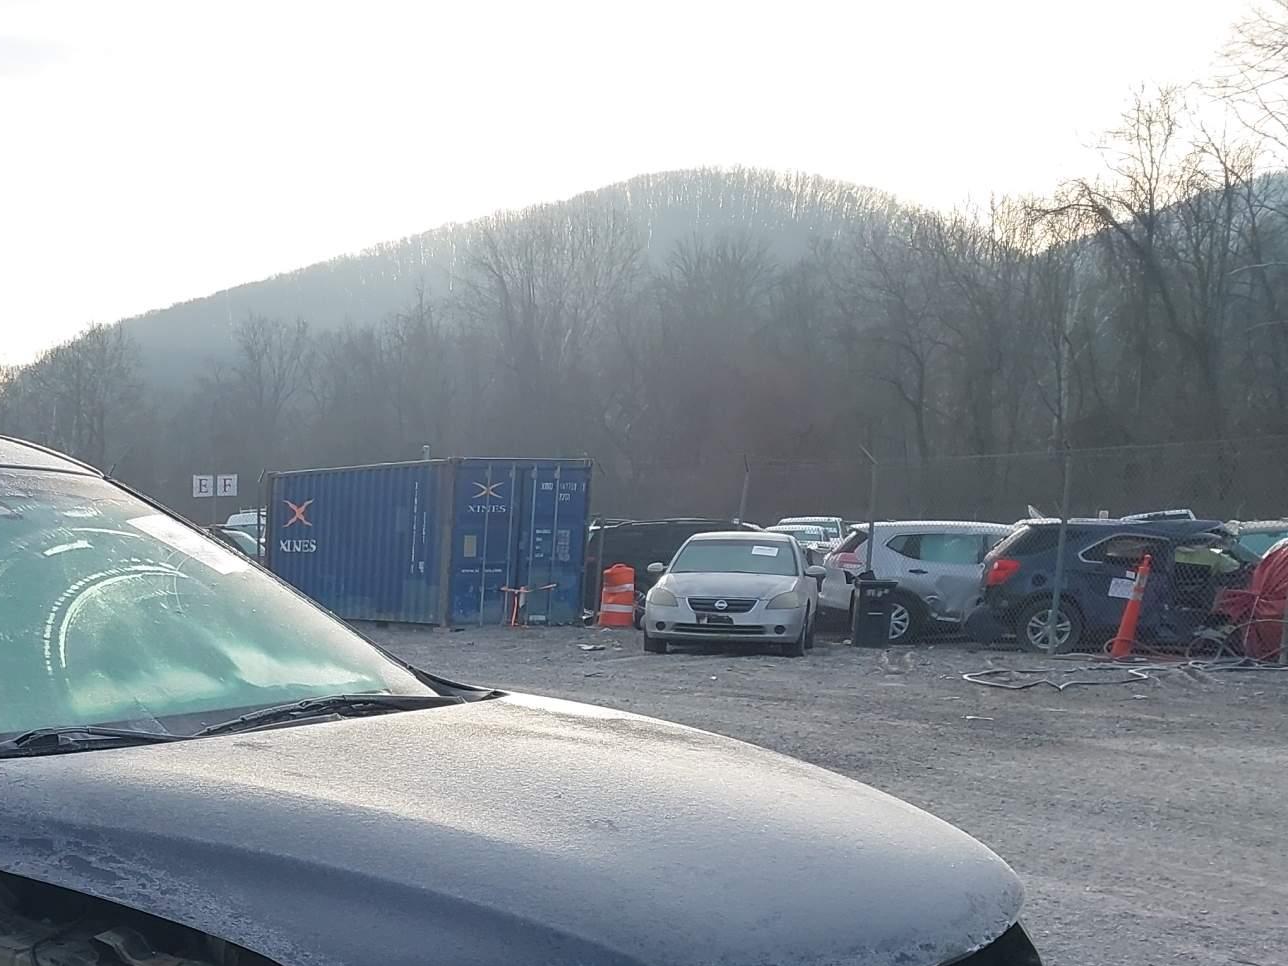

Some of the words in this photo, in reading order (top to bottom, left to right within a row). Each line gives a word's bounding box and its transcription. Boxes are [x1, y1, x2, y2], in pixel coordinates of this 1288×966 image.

[198, 478, 209, 494] E
[223, 478, 233, 493] F
[279, 539, 317, 553] XINES
